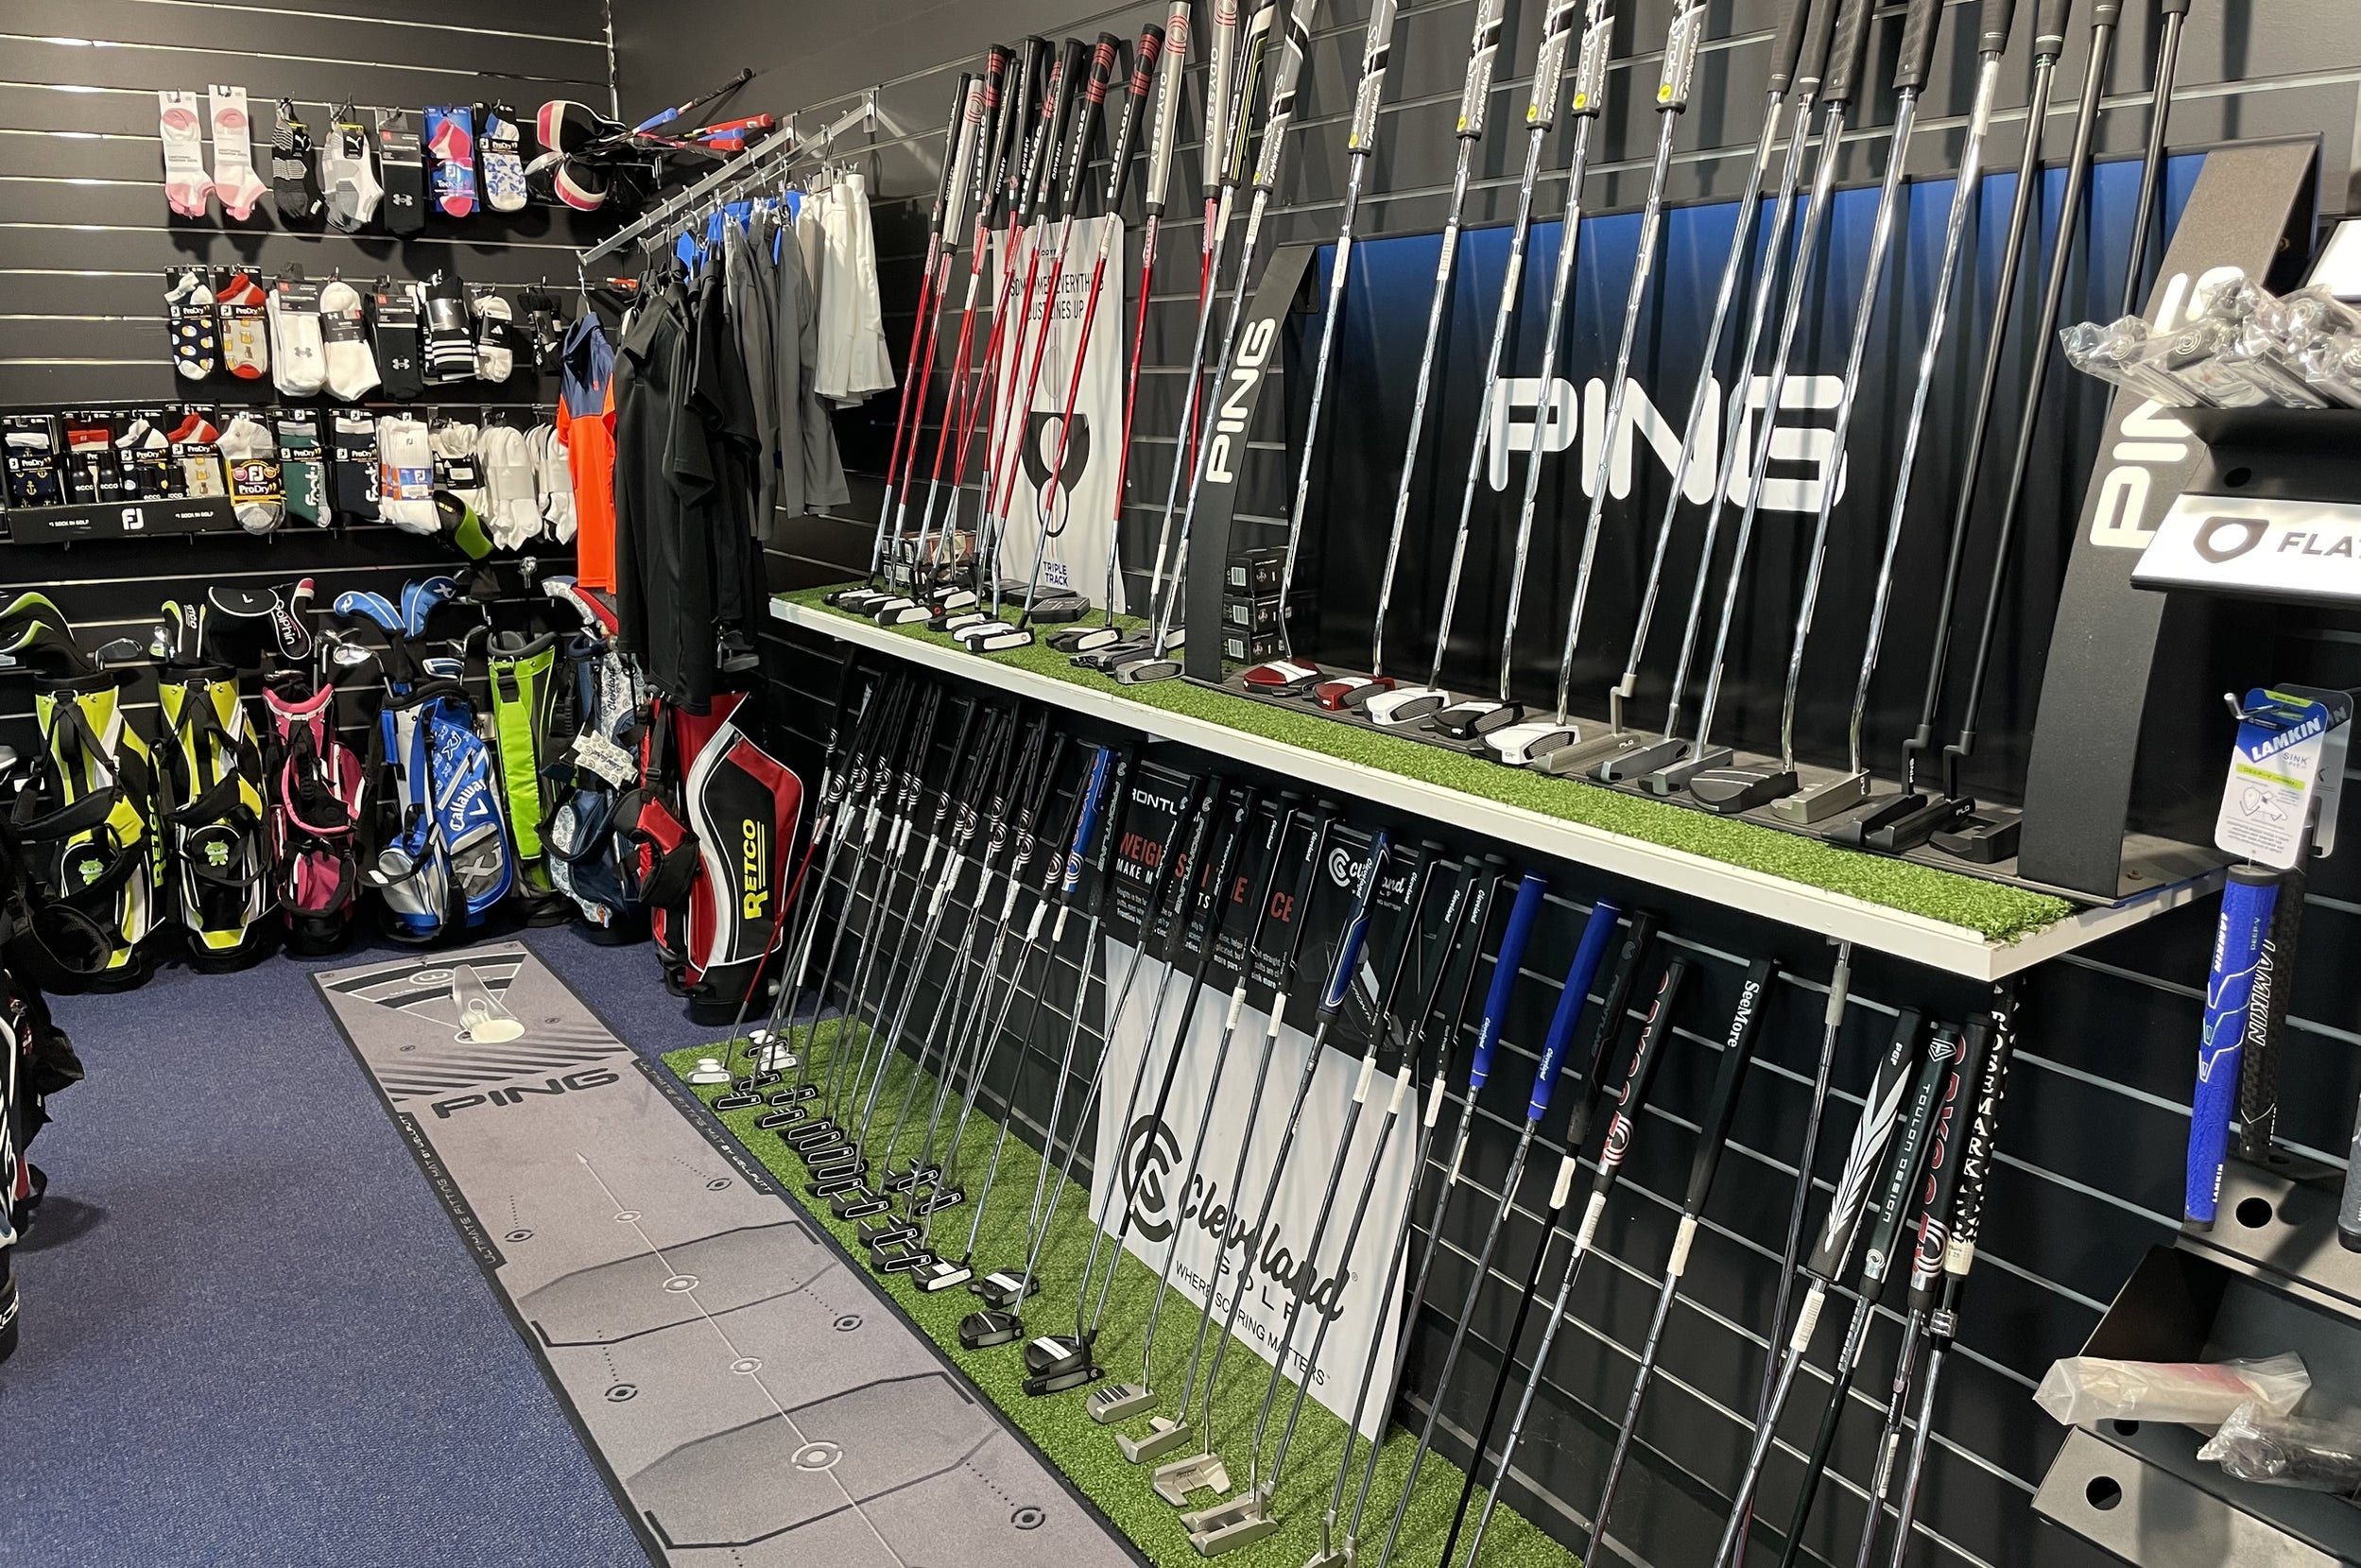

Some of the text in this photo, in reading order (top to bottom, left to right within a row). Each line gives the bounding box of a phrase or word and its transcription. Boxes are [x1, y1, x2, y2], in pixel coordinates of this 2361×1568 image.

[1205, 47, 1219, 147] ODYSSEY
[1150, 72, 1168, 166] ODYSSEY
[220, 305, 233, 318] FJ
[1073, 299, 1085, 319] UP
[1206, 318, 1276, 484] PING
[121, 450, 132, 461] FJ
[172, 443, 184, 455] FJ
[1489, 374, 1848, 513] PING
[238, 484, 269, 495] ProDry
[248, 466, 265, 481] FJ
[414, 470, 425, 482] FJ
[121, 508, 145, 531] FJ
[2277, 531, 2361, 559] FLA
[1043, 560, 1068, 576] TRIPLE
[1044, 573, 1069, 587] TRACK
[2250, 717, 2321, 761] LAMKIN
[2283, 751, 2309, 766] SINK
[449, 778, 489, 833] Callaway
[742, 818, 768, 920] RETCO
[1115, 858, 1142, 881] MAKE
[2214, 912, 2230, 974] LAMKIN
[2248, 939, 2277, 1047] LAMKIN
[1727, 980, 1760, 1048] SeeMore
[431, 1068, 619, 1119] PING
[424, 1159, 442, 1178] MAT
[1883, 1083, 1931, 1223] TOULON DESIGN
[437, 1178, 466, 1215] FITTING
[2212, 1163, 2224, 1203] LAMKIN
[1179, 1173, 1351, 1322] Cleveland
[1176, 1261, 1212, 1297] WHERE
[1215, 1292, 1266, 1342] SCRING
